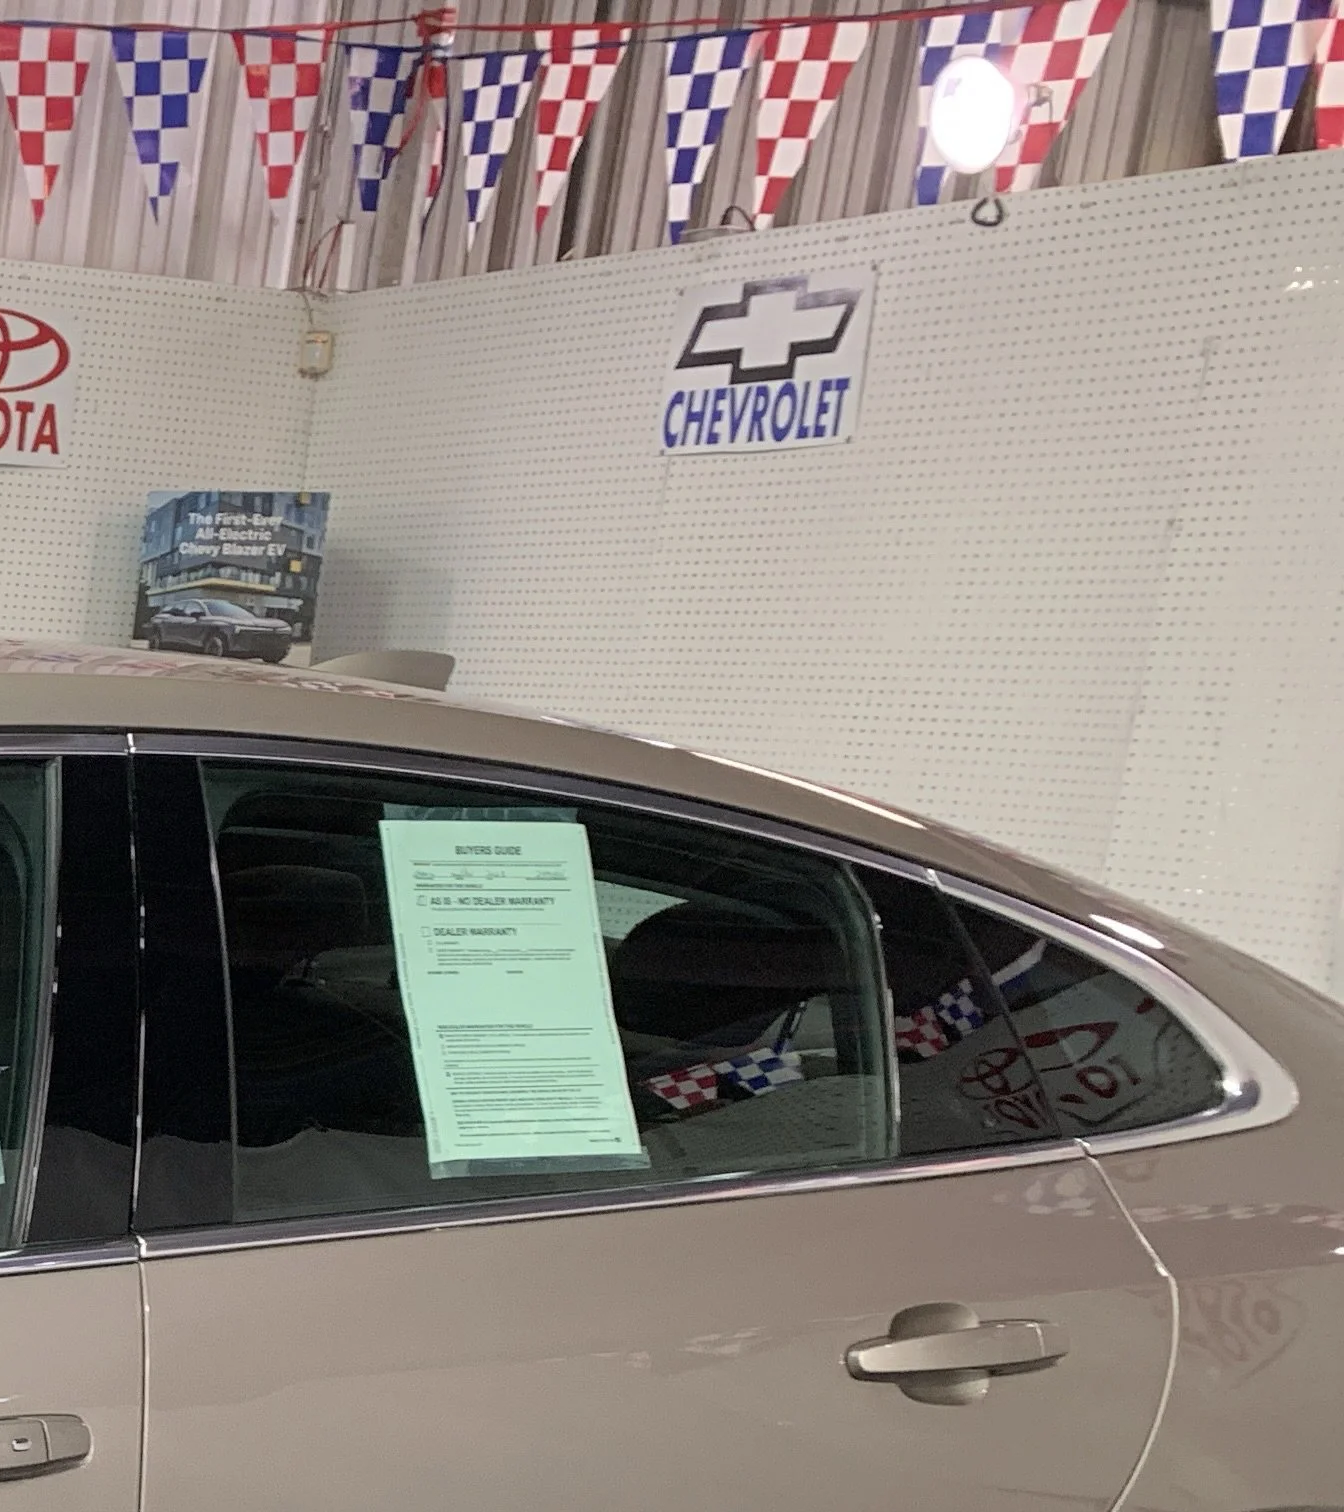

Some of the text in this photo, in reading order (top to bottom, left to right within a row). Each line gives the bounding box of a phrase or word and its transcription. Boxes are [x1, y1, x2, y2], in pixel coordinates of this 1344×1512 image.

[663, 375, 851, 449] CHEVROLET
[188, 511, 284, 526] The First-Ever
[194, 527, 273, 541] All-Electric
[178, 541, 288, 557] Chevy Blazer EV
[494, 845, 523, 856] GUIDE
